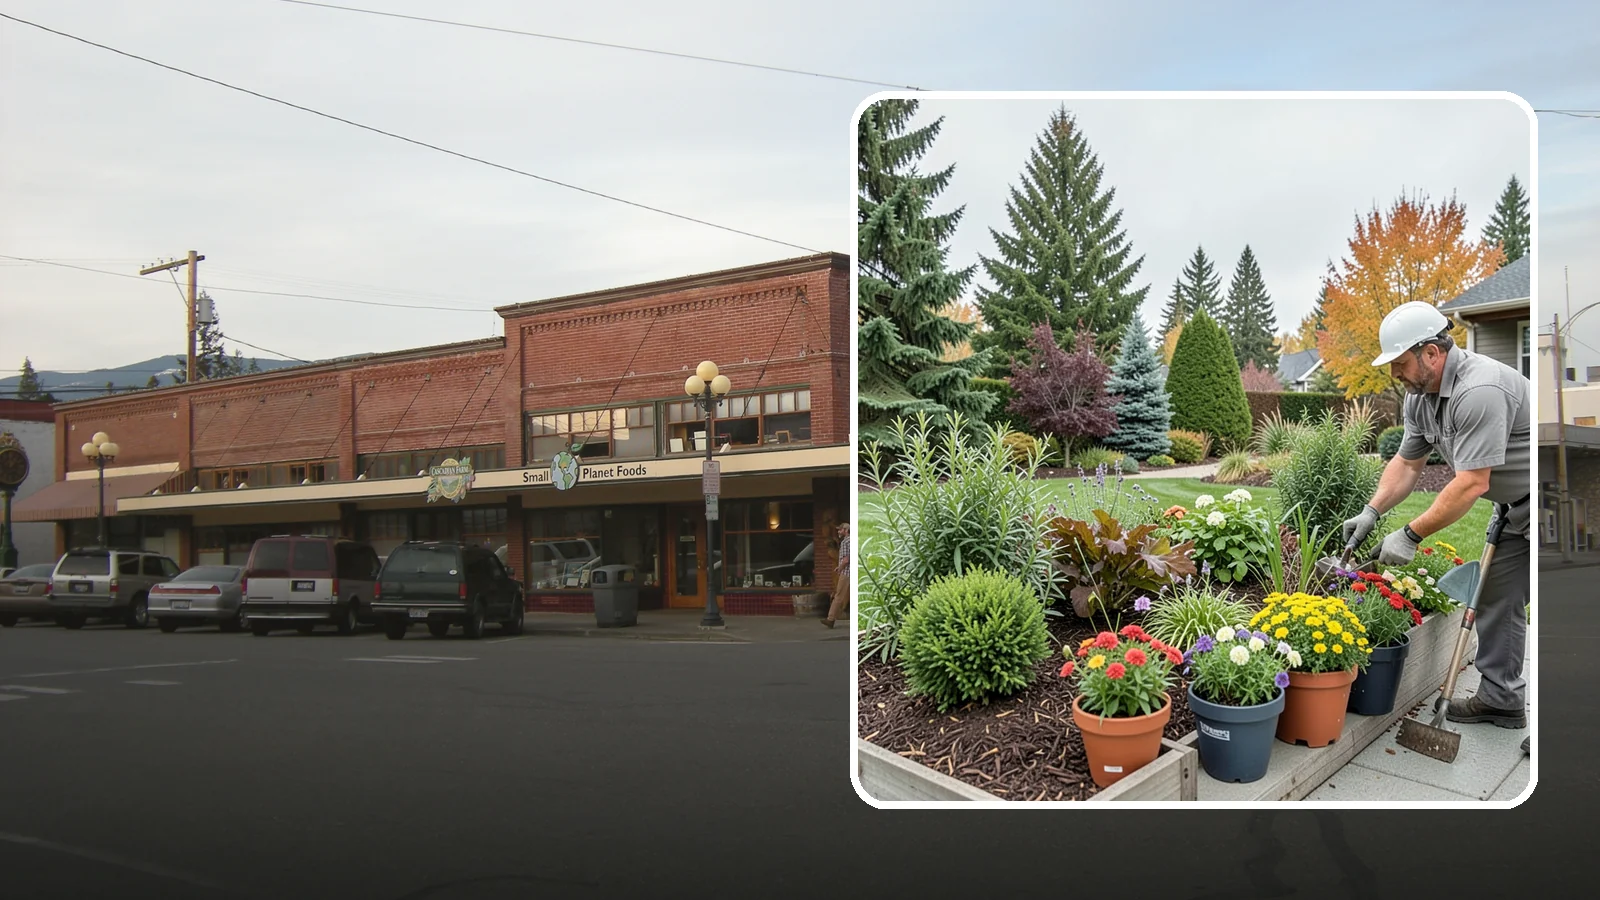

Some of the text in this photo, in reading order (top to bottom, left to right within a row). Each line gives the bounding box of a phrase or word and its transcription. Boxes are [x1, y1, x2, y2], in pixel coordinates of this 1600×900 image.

[523, 464, 647, 483] Small Planet Foods
